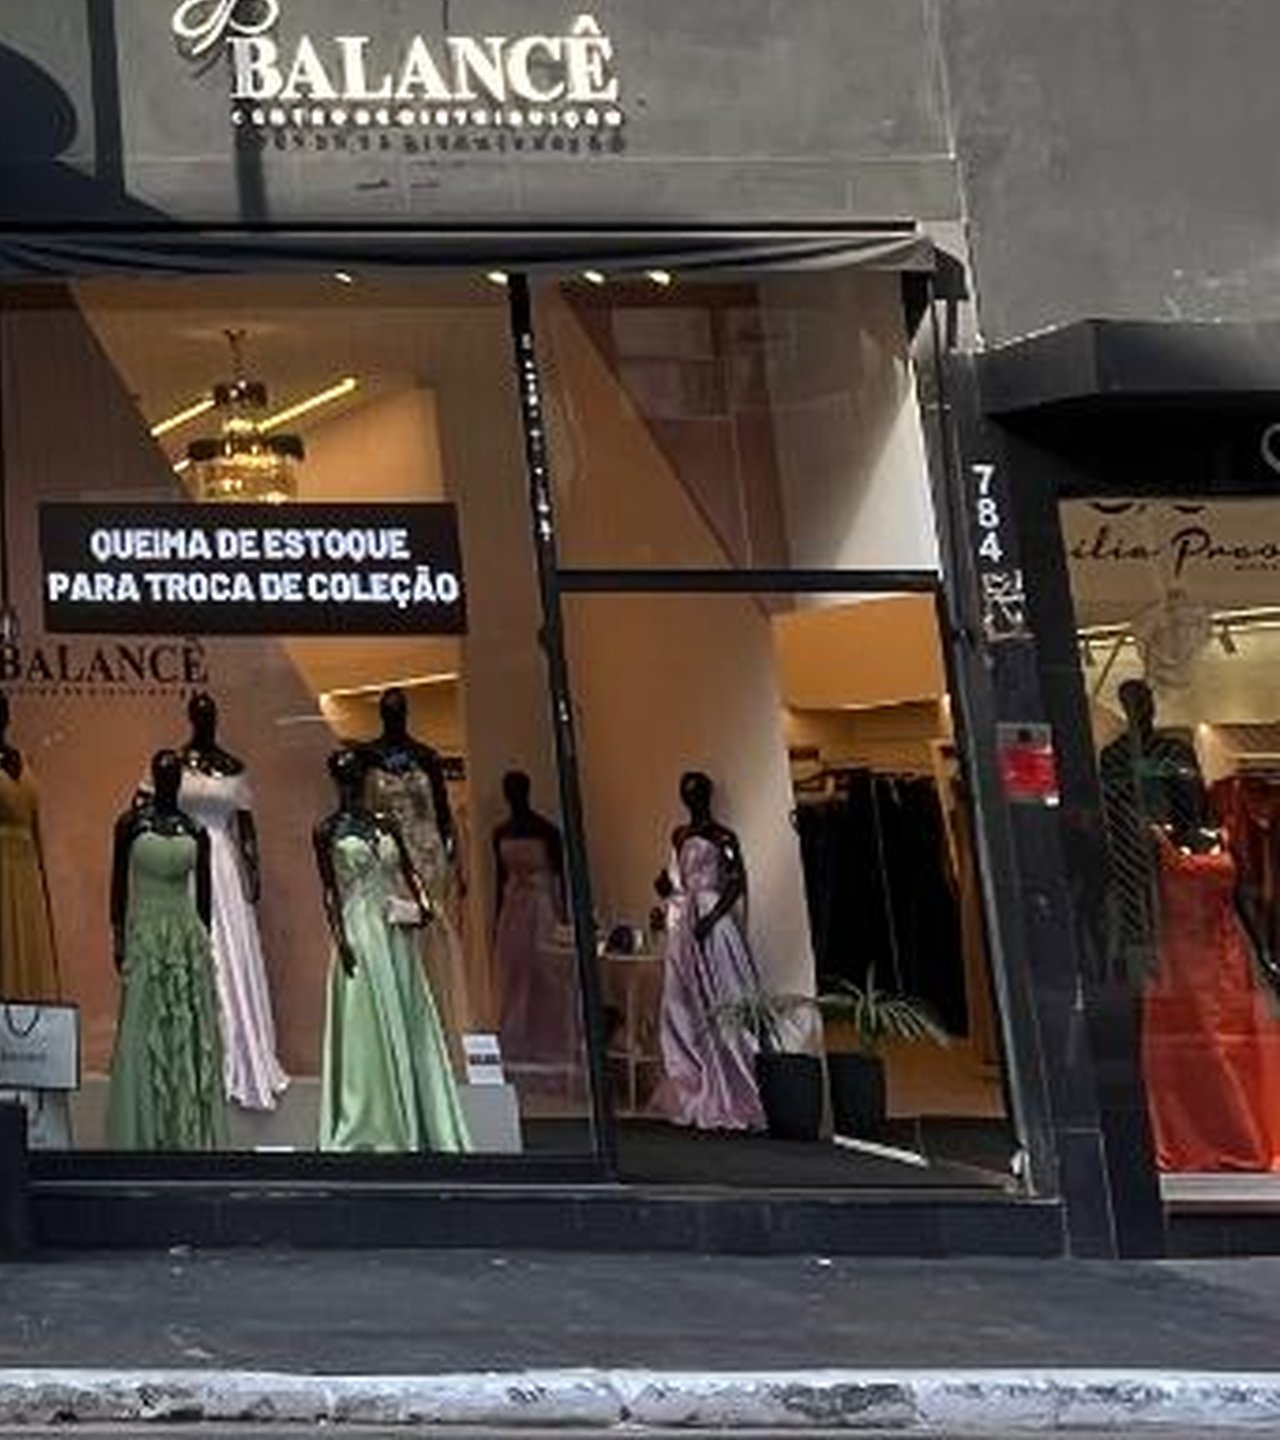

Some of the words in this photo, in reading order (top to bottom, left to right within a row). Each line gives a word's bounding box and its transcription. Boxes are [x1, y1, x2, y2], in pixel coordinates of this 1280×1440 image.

[229, 13, 619, 102] BALANCÊ
[90, 527, 214, 561] QUEIMA
[215, 529, 259, 560] DE
[262, 527, 412, 562] ESTOQUE
[971, 464, 1004, 563] 784
[48, 572, 141, 601] PARA
[144, 572, 257, 602] TROCA
[259, 573, 305, 601] DE
[306, 565, 459, 607] COLEÇÃO
